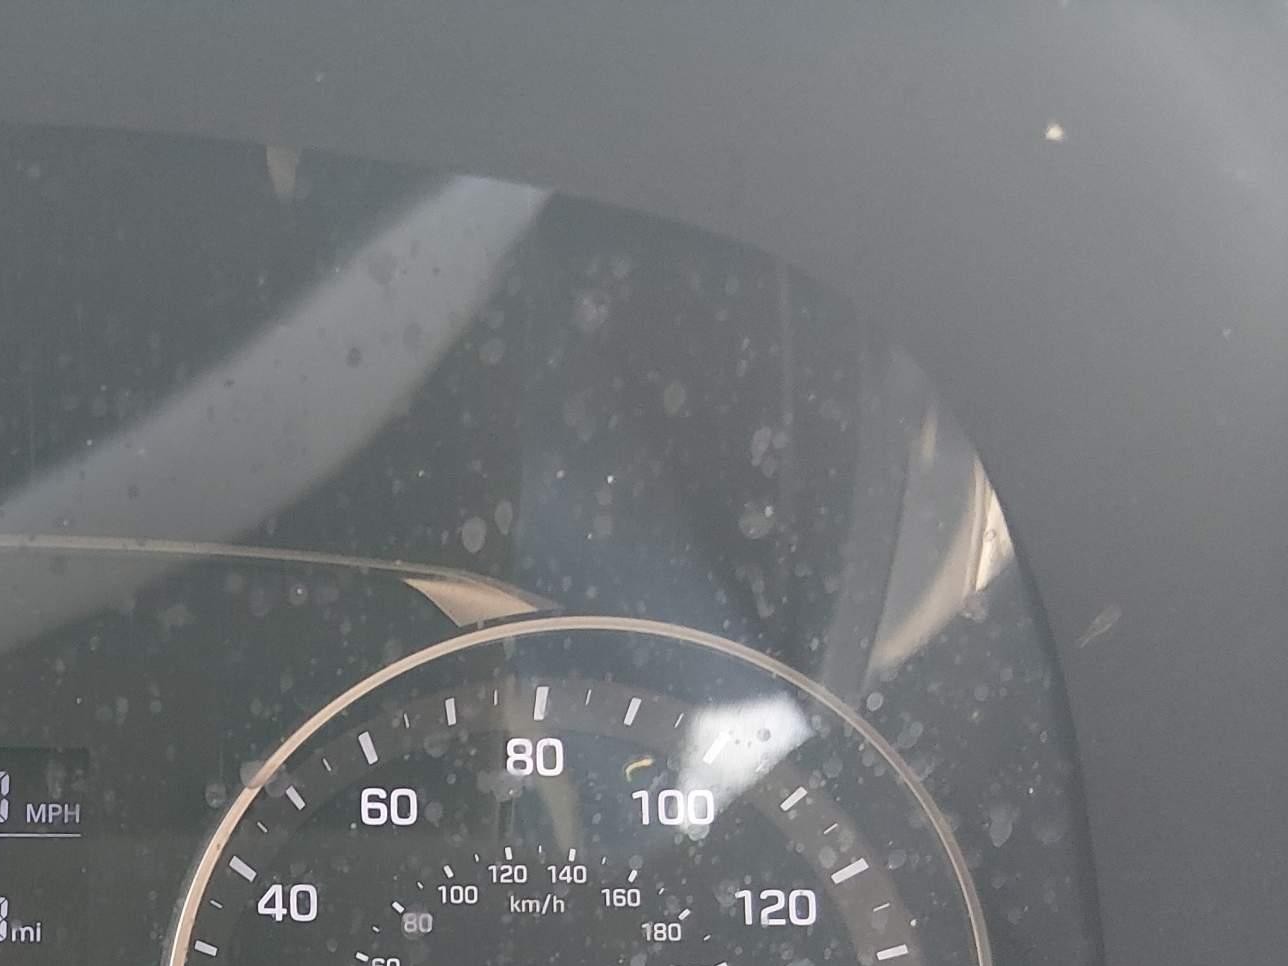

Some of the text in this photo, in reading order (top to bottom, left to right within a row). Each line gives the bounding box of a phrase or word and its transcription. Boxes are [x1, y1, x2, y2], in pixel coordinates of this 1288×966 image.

[506, 739, 563, 776] 80
[26, 804, 80, 823] MPH
[360, 789, 417, 826] 60
[632, 789, 714, 827] 100
[488, 865, 527, 883] 120
[547, 865, 587, 884] 140
[257, 885, 318, 922] 40
[438, 886, 478, 904] 100
[509, 894, 565, 915] km/h
[601, 889, 640, 907] 160
[735, 890, 816, 926] 120
[12, 923, 41, 942] mi
[403, 915, 432, 933] 80
[642, 922, 682, 942] 180
